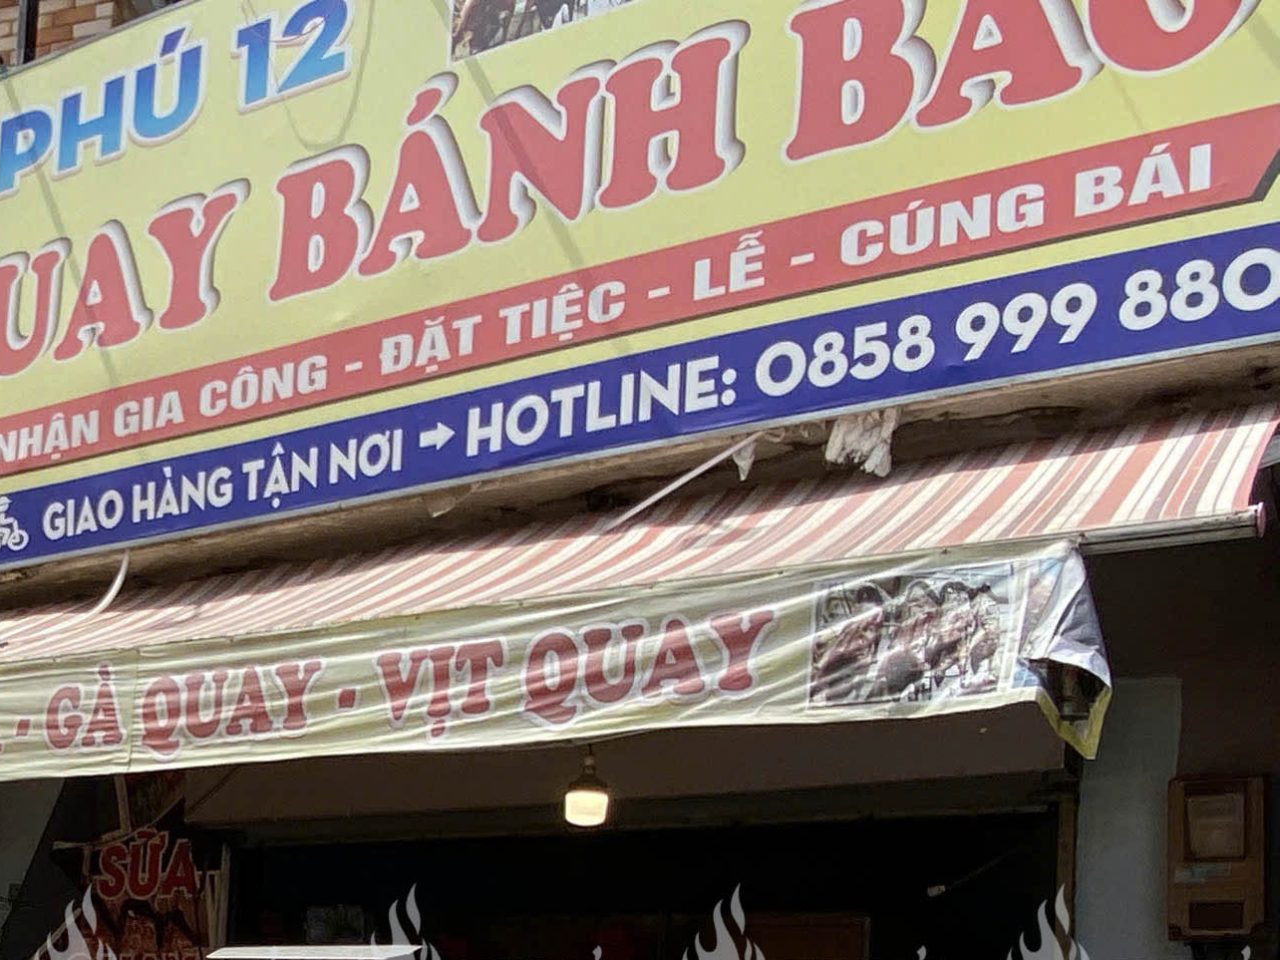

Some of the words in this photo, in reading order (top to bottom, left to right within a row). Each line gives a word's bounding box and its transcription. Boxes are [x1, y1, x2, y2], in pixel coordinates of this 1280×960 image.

[236, 0, 354, 110] 12
[268, 20, 750, 301] BÁNH
[42, 491, 124, 541] GIAO
[132, 466, 234, 524] HÀNG
[242, 441, 318, 509] TẬN
[329, 427, 404, 484] NƠI
[466, 356, 739, 457] HOTLINE:
[755, 314, 936, 397] 0858
[955, 283, 1098, 362] 999
[1118, 247, 1280, 331] 880
[113, 387, 185, 439] GIA
[199, 355, 328, 417] CÔNG
[380, 313, 483, 374] ĐẶT
[499, 284, 625, 343] TIỆC
[693, 231, 768, 302] LỄ
[840, 183, 1045, 266] CÚNG
[1074, 142, 1212, 218] BÁI
[44, 663, 124, 751] GÀ
[138, 659, 325, 761] QUAY
[376, 638, 507, 739] VỊT
[523, 609, 776, 729] QUAY
[96, 826, 198, 899] SỮA
